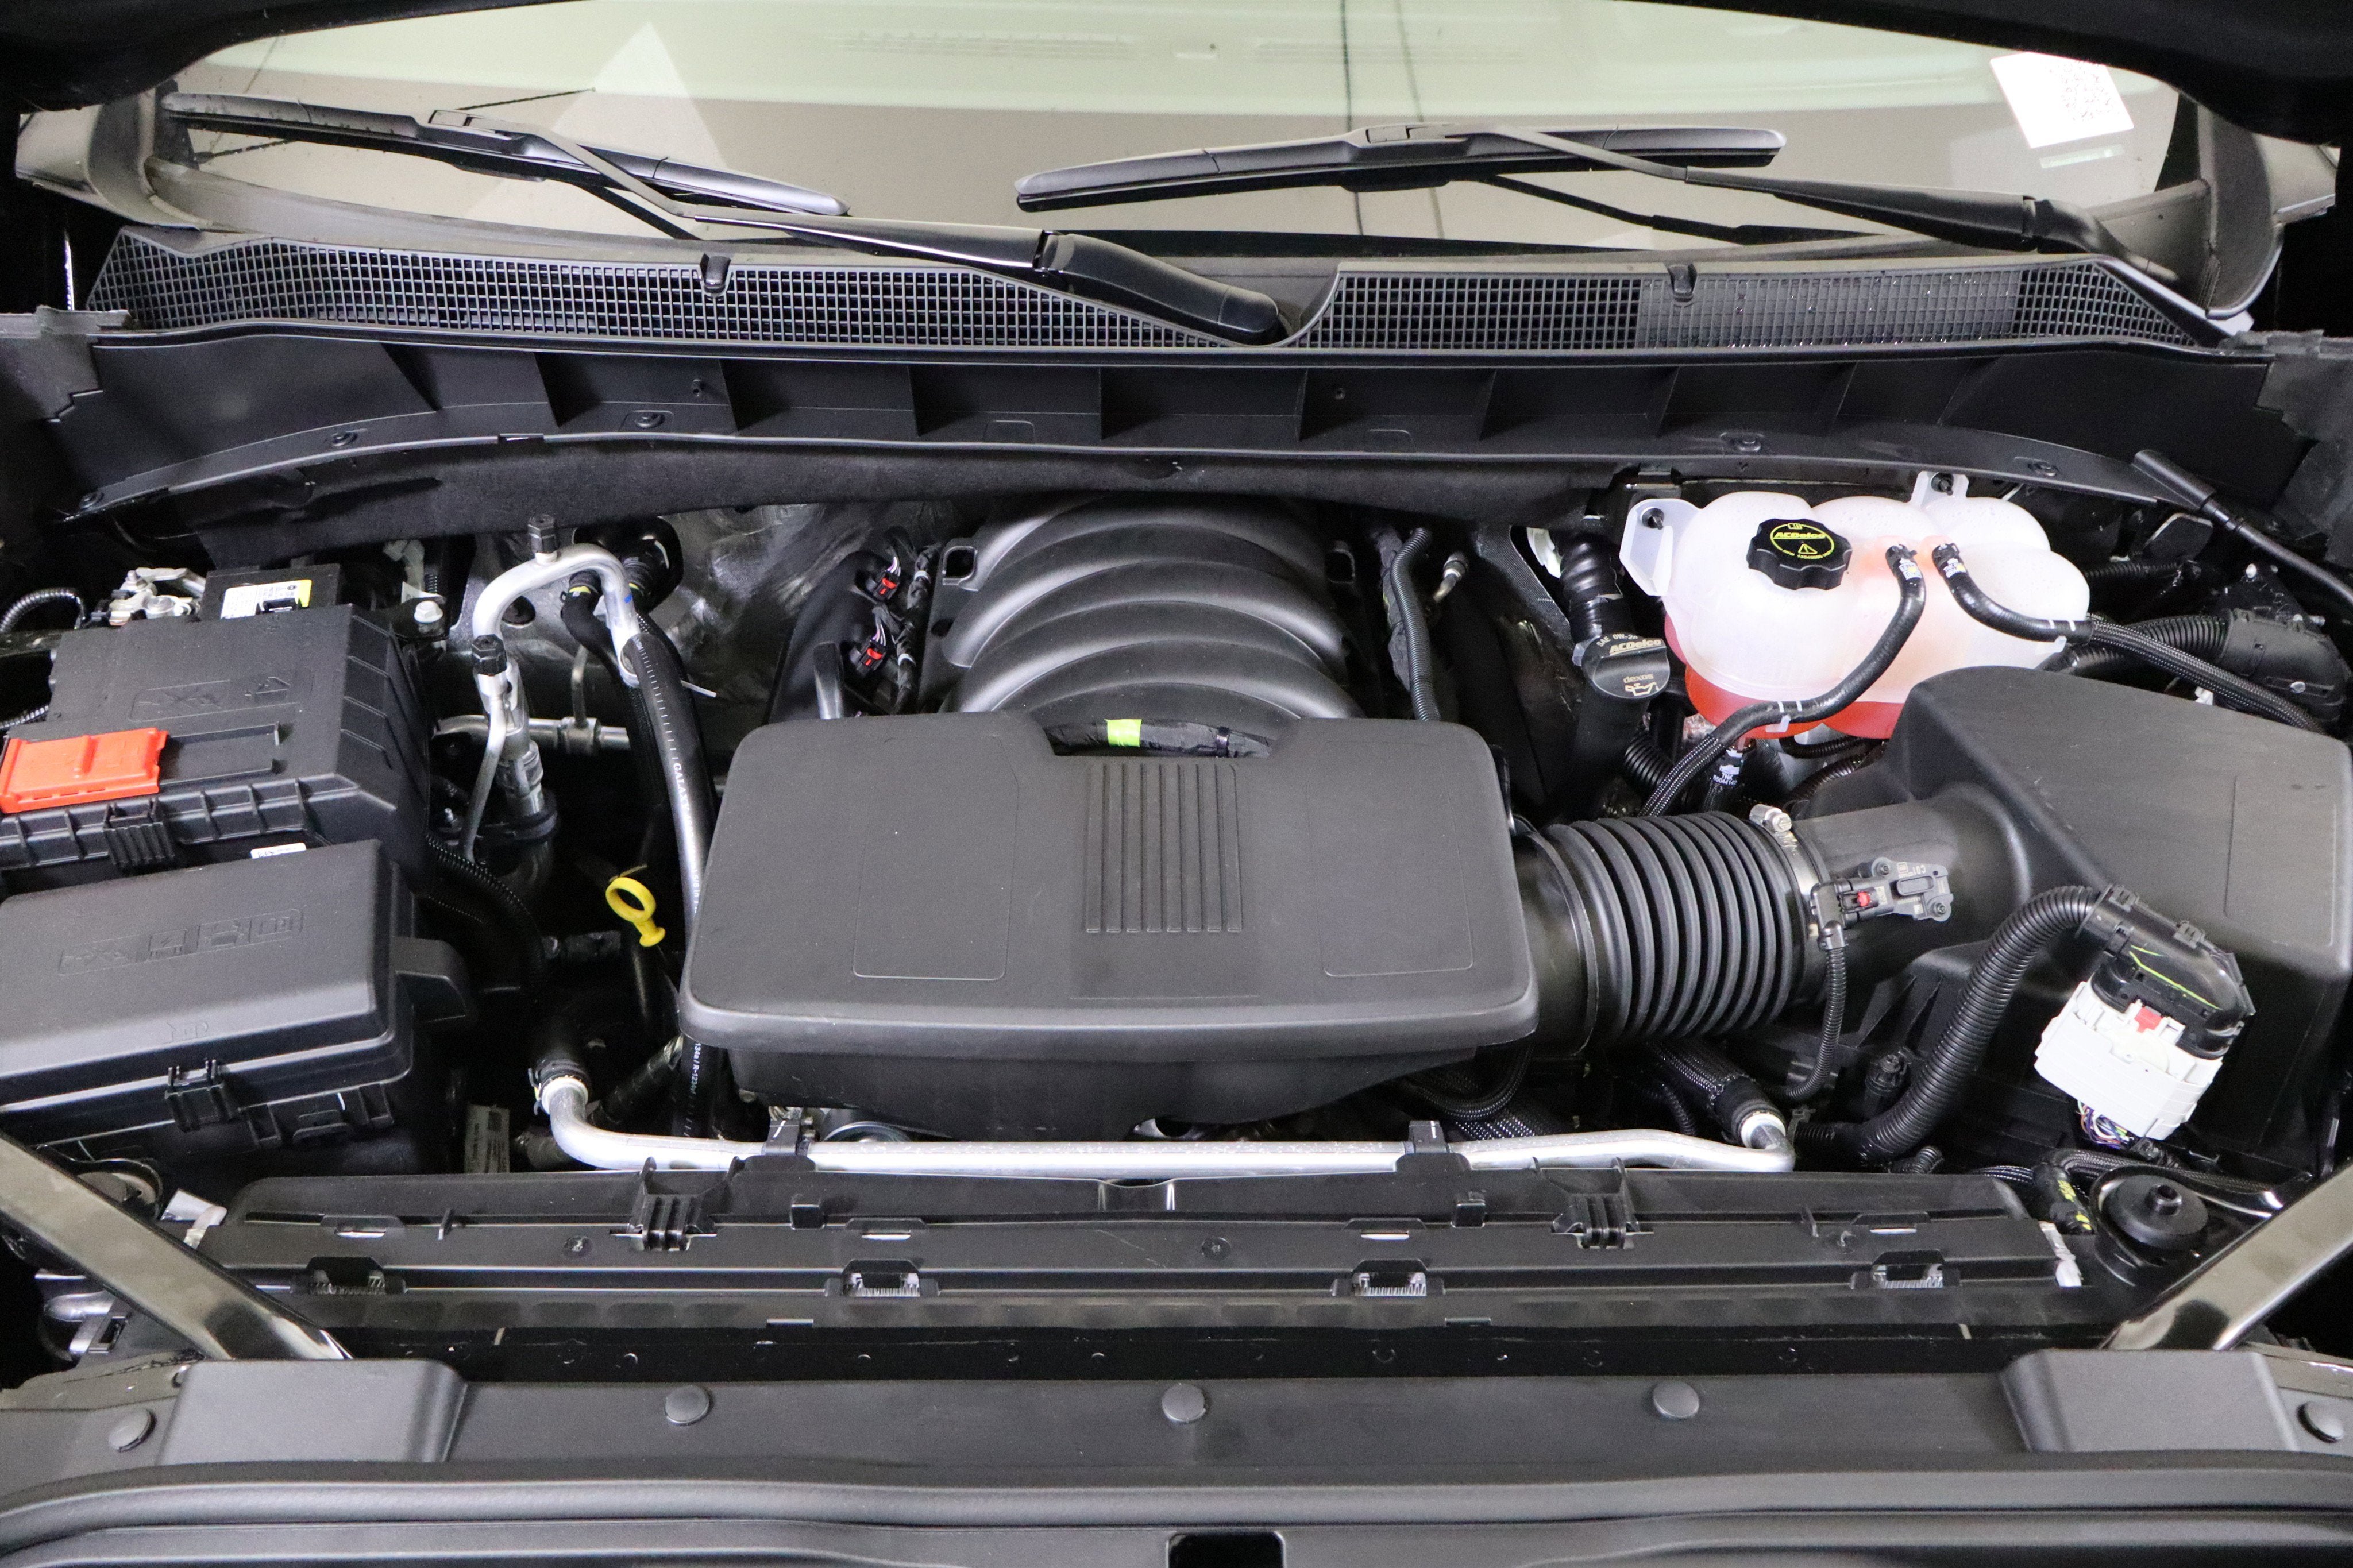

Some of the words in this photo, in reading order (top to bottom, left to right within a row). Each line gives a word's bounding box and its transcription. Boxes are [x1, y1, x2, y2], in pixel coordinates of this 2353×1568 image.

[1596, 636, 1611, 647] SAE
[1609, 639, 1662, 654] ACDelco
[1623, 674, 1654, 683] dexos
[673, 762, 691, 811] GALAXY
[692, 874, 700, 888] 5/8
